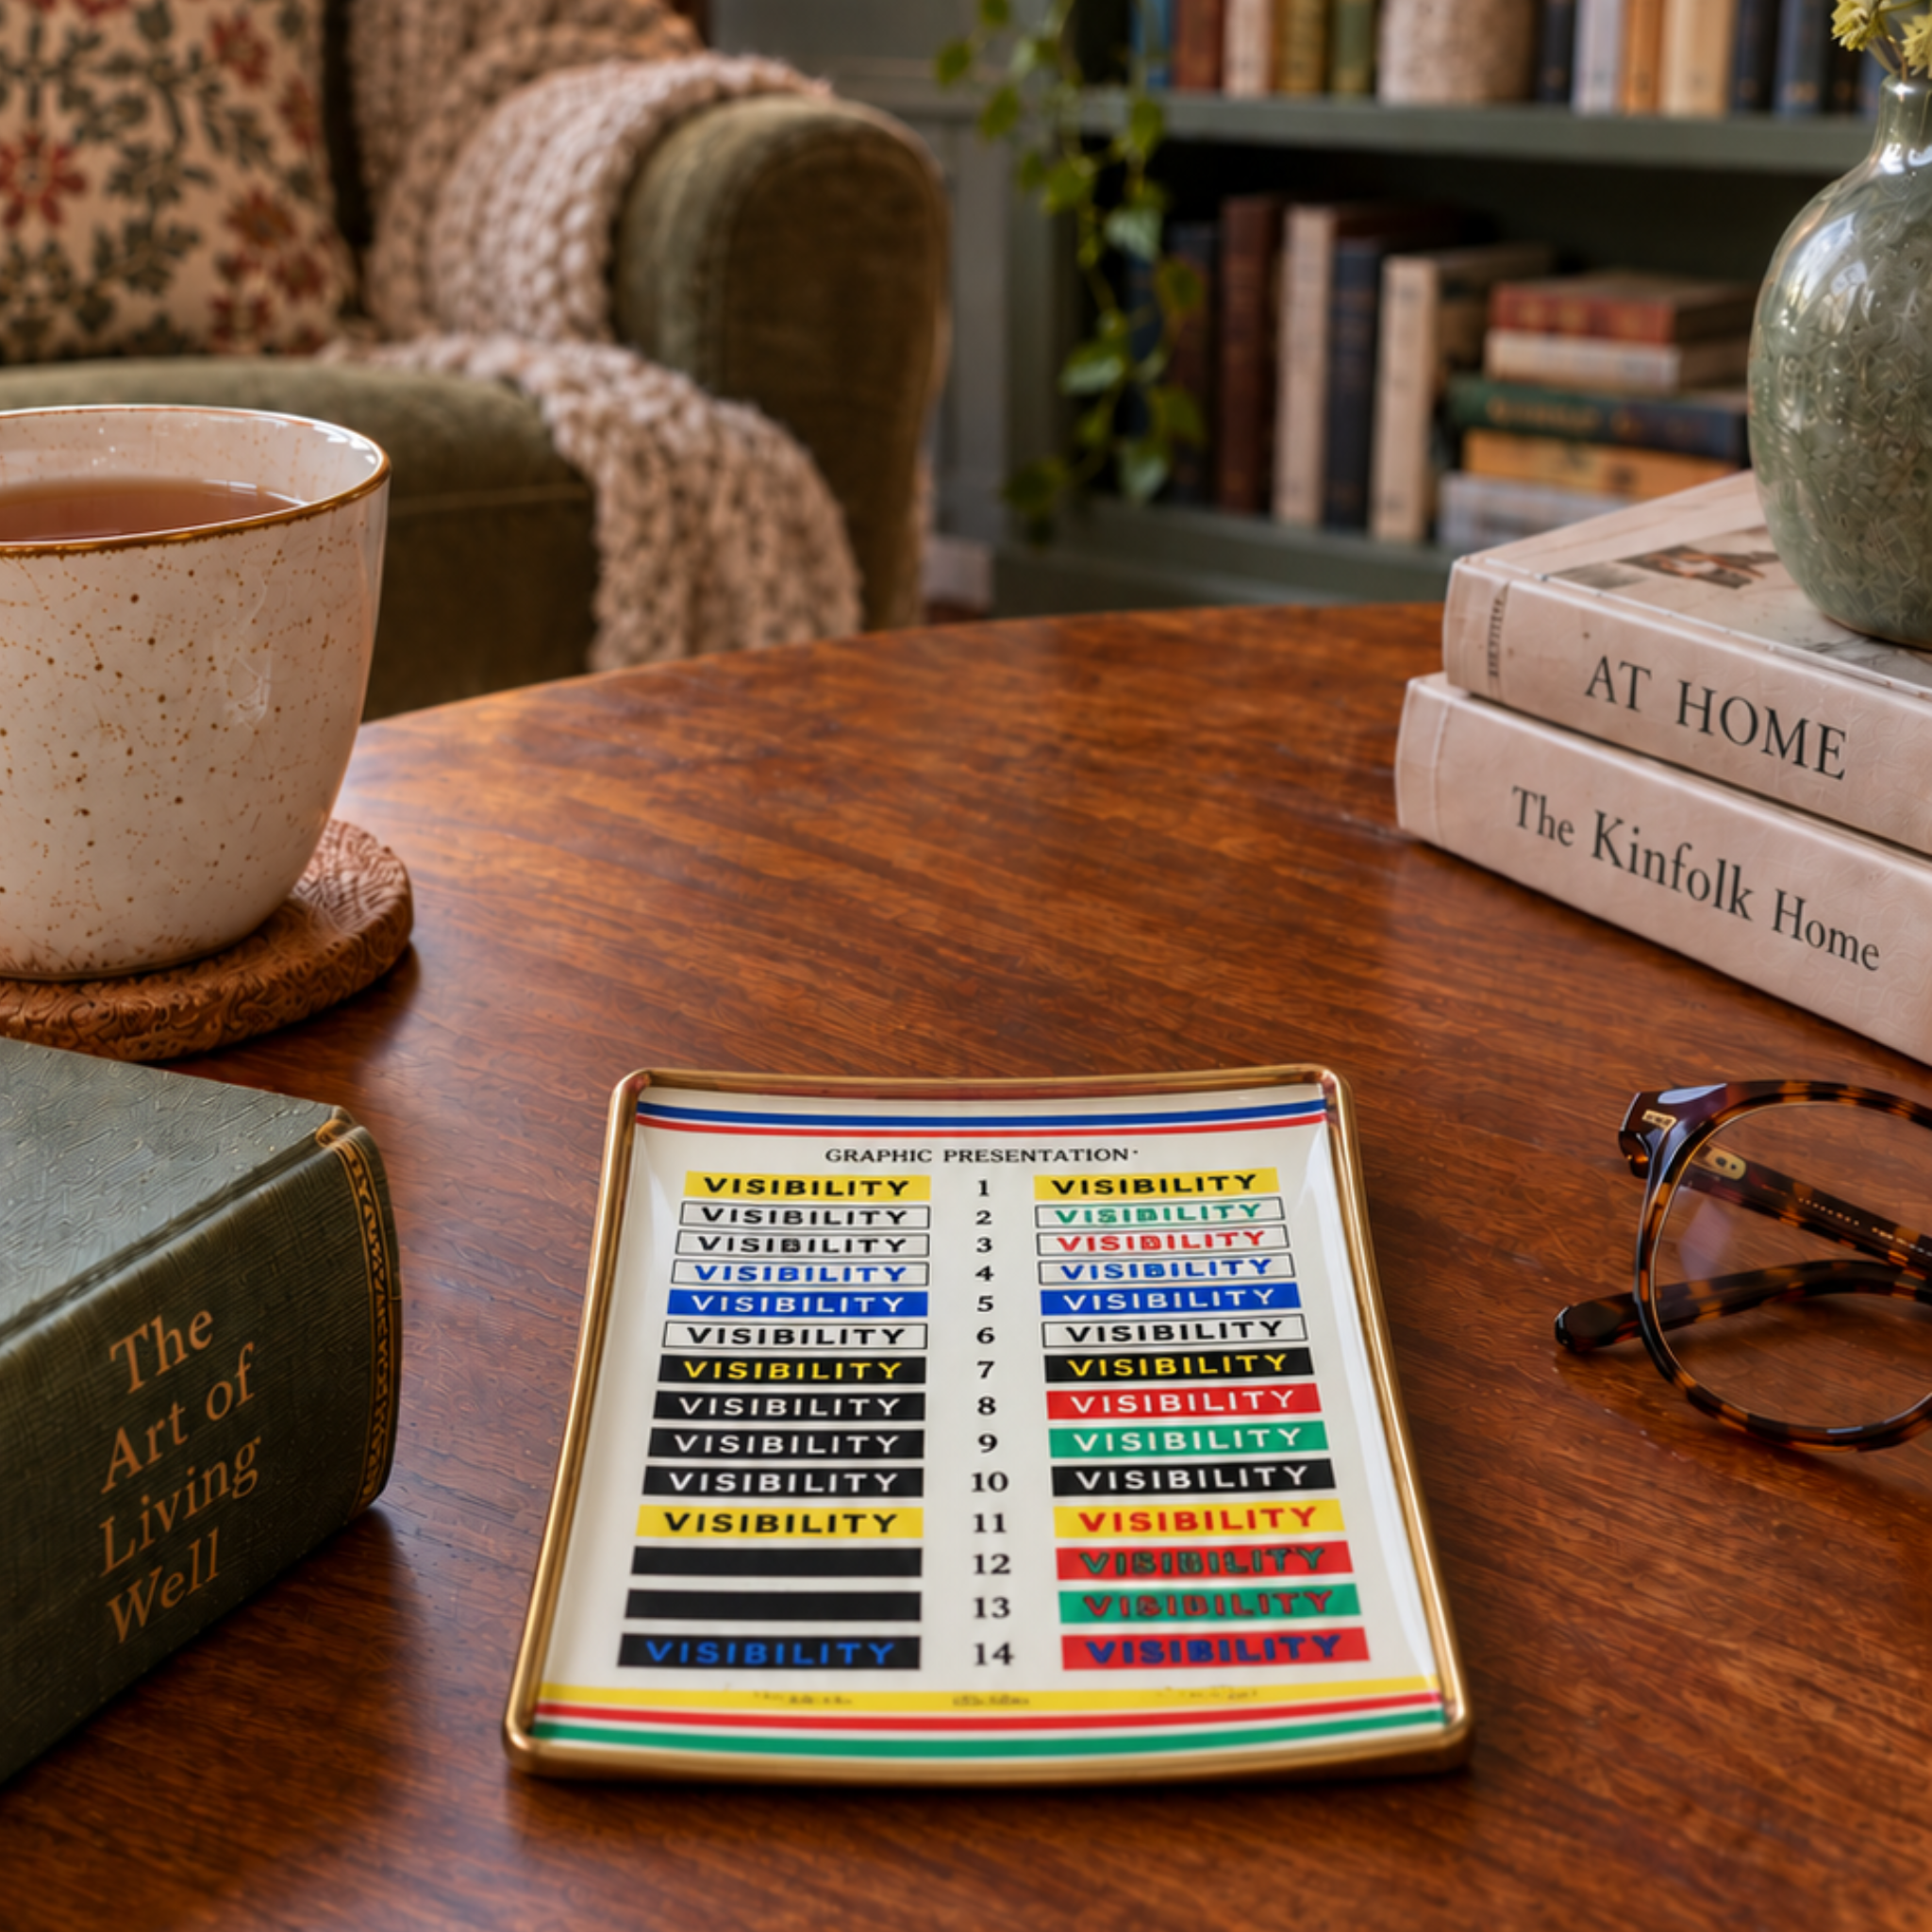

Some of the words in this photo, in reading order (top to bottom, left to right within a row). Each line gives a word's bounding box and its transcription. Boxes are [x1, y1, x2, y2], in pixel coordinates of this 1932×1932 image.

[1583, 655, 1652, 713] AT
[1674, 679, 1847, 781] HOME
[1511, 785, 1574, 848] The
[1591, 808, 1756, 923] Kinfolk
[1770, 888, 1880, 972] Home
[824, 1147, 933, 1164] GRAPHIC
[704, 1176, 909, 1197] VISIBILITY
[978, 1179, 990, 1197] 1
[1051, 1174, 1257, 1195] VISIBILITY
[701, 1207, 908, 1225] VISIBILITY
[975, 1209, 992, 1225] 2
[1054, 1203, 1262, 1224] VISIBILITY
[697, 1236, 907, 1254] VISIBILITY
[975, 1236, 993, 1254] 3
[694, 1264, 907, 1283] VISIBILITY
[974, 1264, 994, 1282] 4
[1060, 1258, 1273, 1281] VISIBILITY
[691, 1294, 905, 1313] VISIBILITY
[976, 1294, 994, 1312] 5
[1062, 1288, 1275, 1311] VISIBILITY
[687, 1326, 906, 1346] VISIBILITY
[975, 1326, 995, 1345] 6
[1065, 1320, 1283, 1343] VISIBILITY
[108, 1308, 214, 1395] The
[683, 1360, 903, 1380] VISIBILITY
[976, 1360, 995, 1380] 7
[1067, 1353, 1288, 1377] VISIBILITY
[678, 1396, 901, 1415] VISIBILITY
[976, 1396, 997, 1416] 8
[1071, 1390, 1295, 1414] VISIBILITY
[100, 1400, 189, 1494] Art
[206, 1341, 255, 1422] of
[674, 1434, 900, 1455] VISIBILITY
[977, 1432, 998, 1454] 9
[1073, 1427, 1302, 1453] VISIBILITY
[668, 1472, 898, 1493] VISIBILITY
[971, 1471, 1009, 1493] 10
[1074, 1465, 1308, 1491] VISIBILITY
[99, 1435, 262, 1578] Living
[663, 1511, 898, 1534] VISIBILITY
[973, 1512, 1007, 1534] 11
[1078, 1506, 1318, 1534] VISIBILITY
[973, 1553, 1011, 1575] 12
[106, 1526, 221, 1645] Well
[973, 1596, 1011, 1620] 13
[645, 1640, 896, 1665] VISIBILITY
[974, 1641, 1015, 1667] 14
[1085, 1634, 1342, 1665] VISIBILITY
